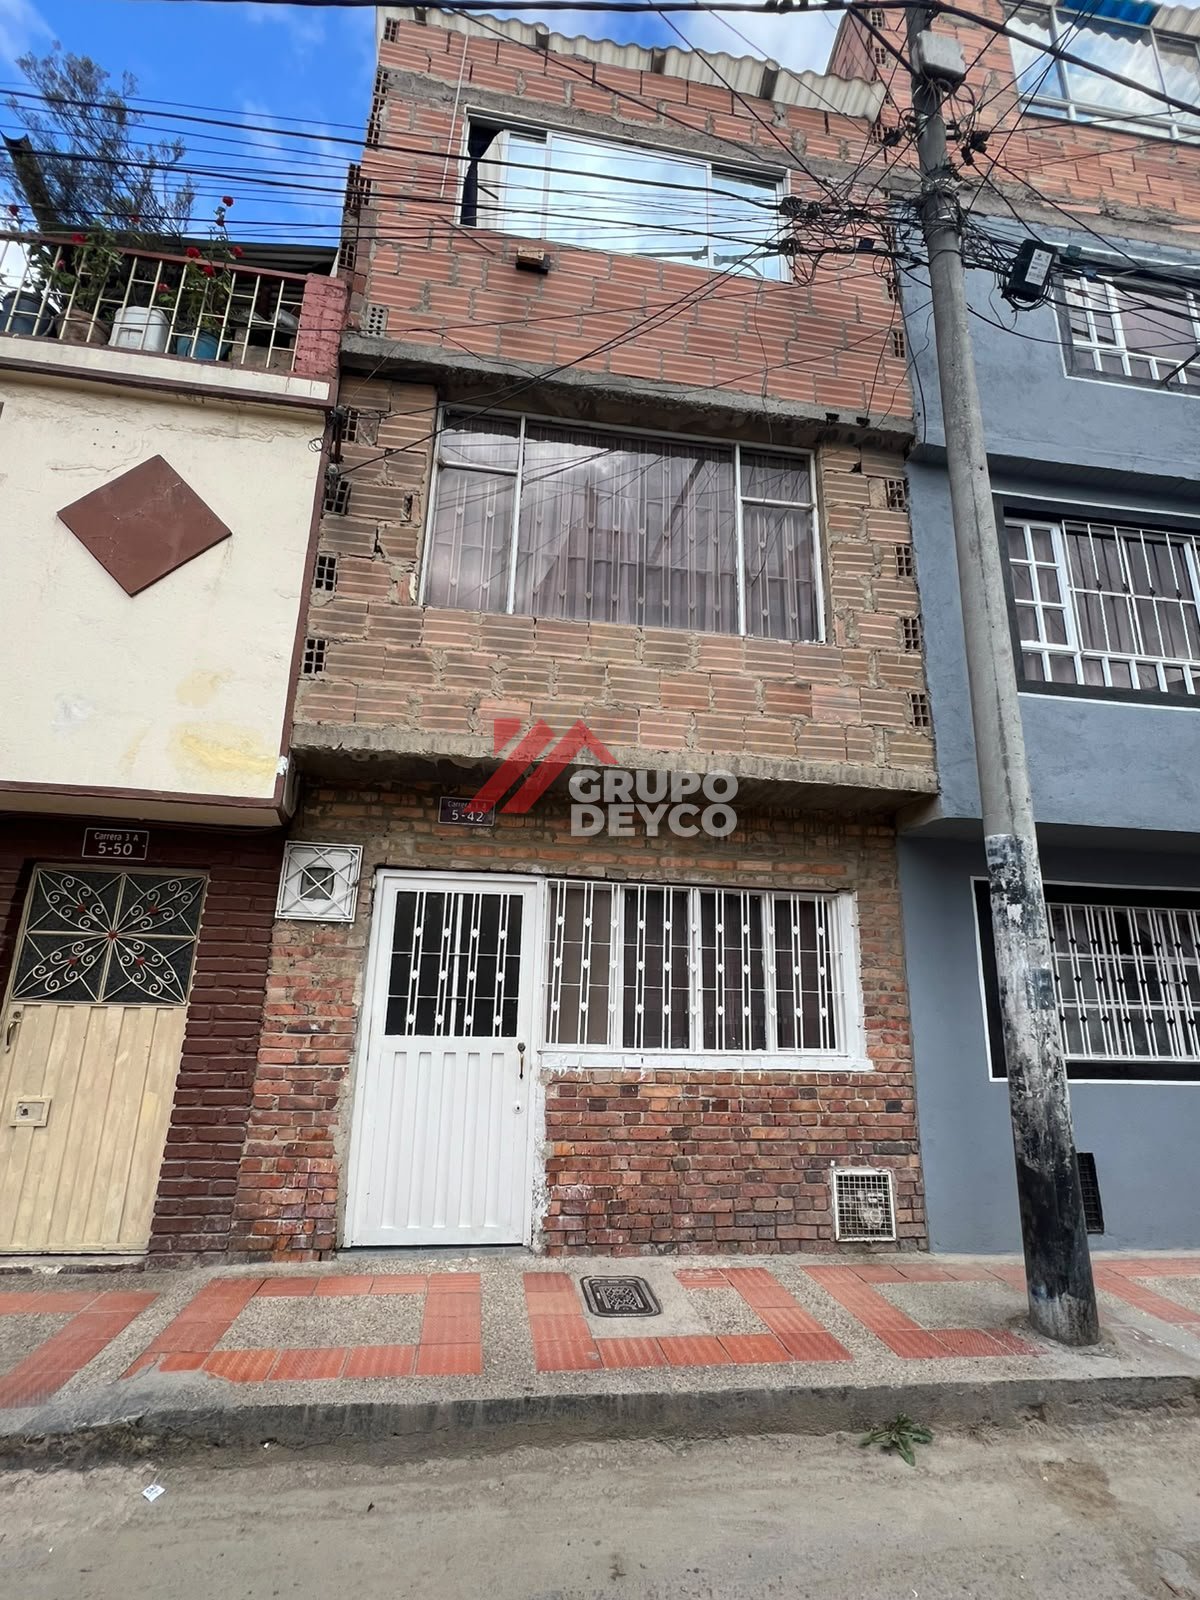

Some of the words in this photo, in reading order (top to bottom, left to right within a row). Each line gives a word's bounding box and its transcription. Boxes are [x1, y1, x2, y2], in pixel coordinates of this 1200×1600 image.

[452, 809, 484, 822] 5-42
[94, 832, 122, 841] Carrera
[125, 833, 130, 841] 3
[133, 834, 139, 842] A
[98, 842, 133, 856] 5-50
